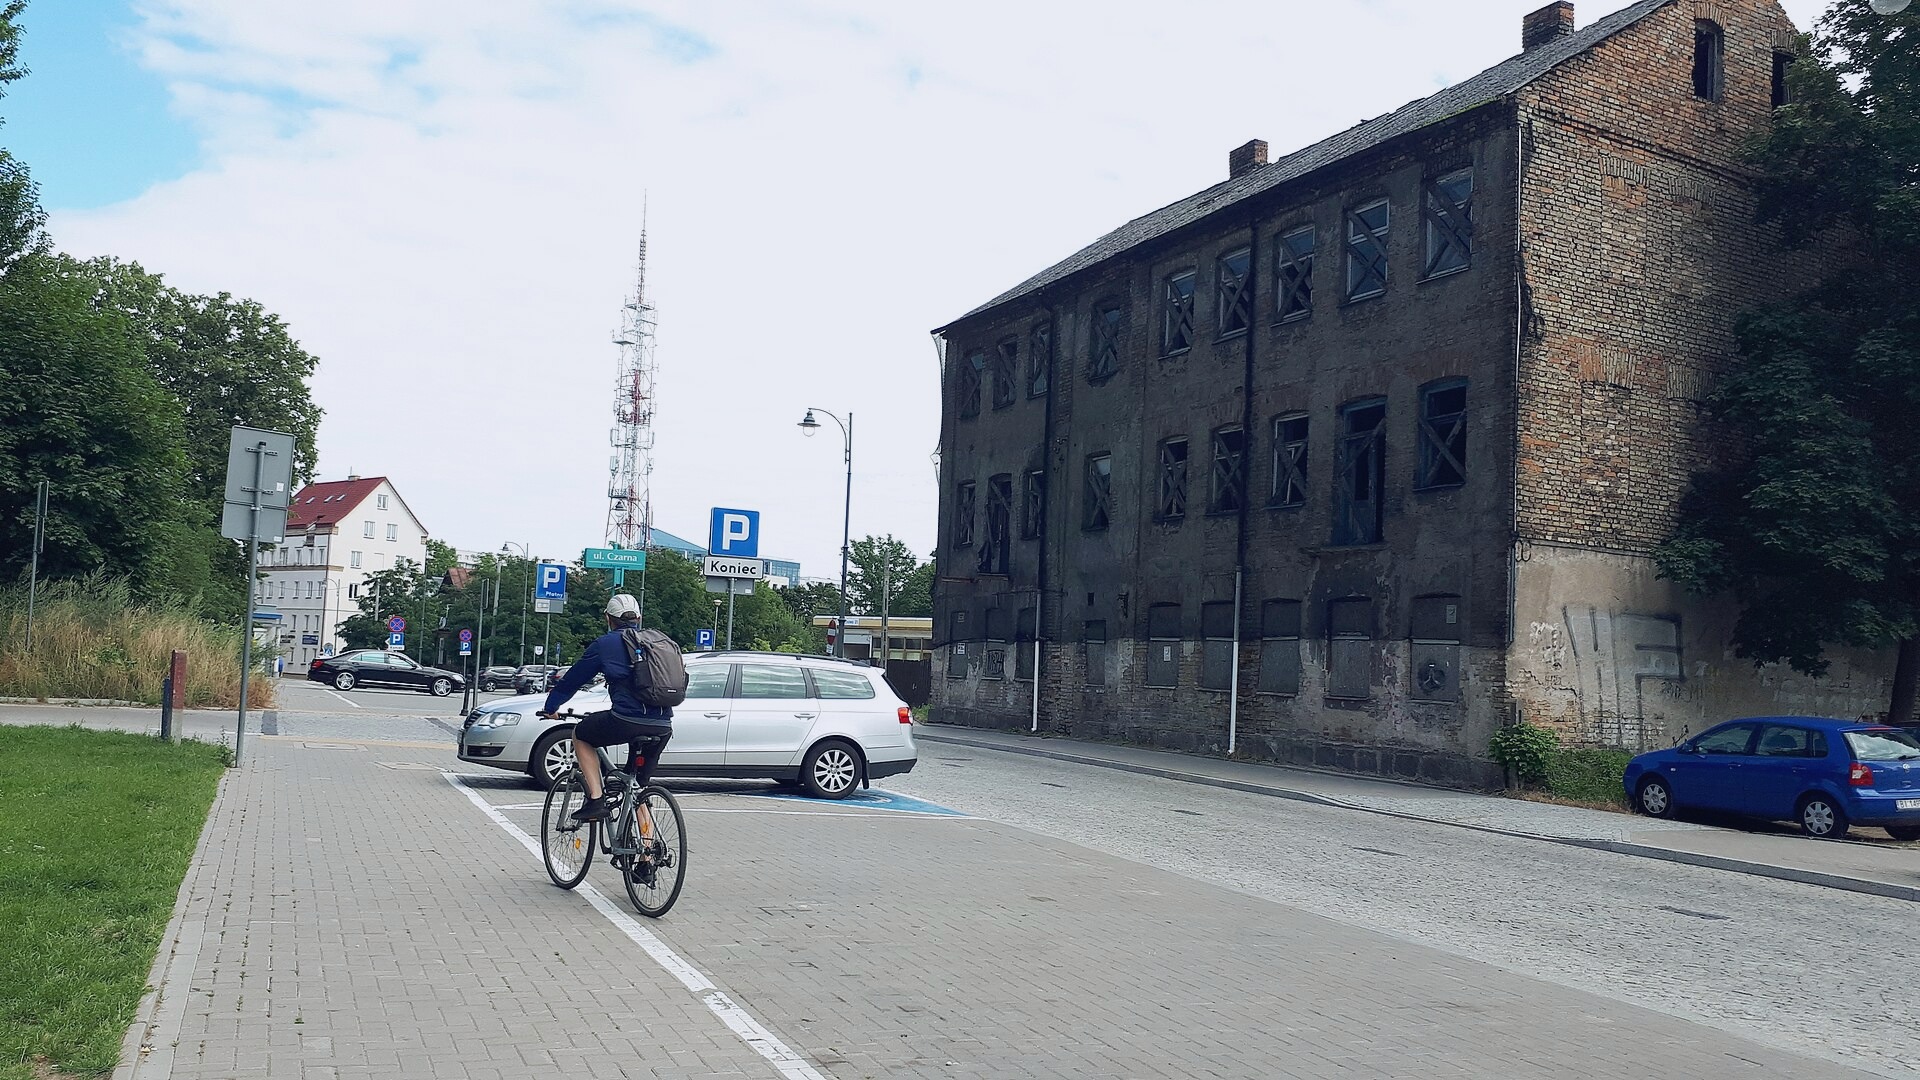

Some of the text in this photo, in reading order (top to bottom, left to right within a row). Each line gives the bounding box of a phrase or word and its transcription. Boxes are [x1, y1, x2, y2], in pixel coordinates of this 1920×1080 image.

[722, 513, 750, 550] P
[593, 551, 638, 562] ul. Czarna
[710, 560, 757, 575] Koniec
[543, 566, 560, 588] P
[392, 633, 401, 643] P
[700, 631, 710, 644] P
[463, 642, 470, 651] P
